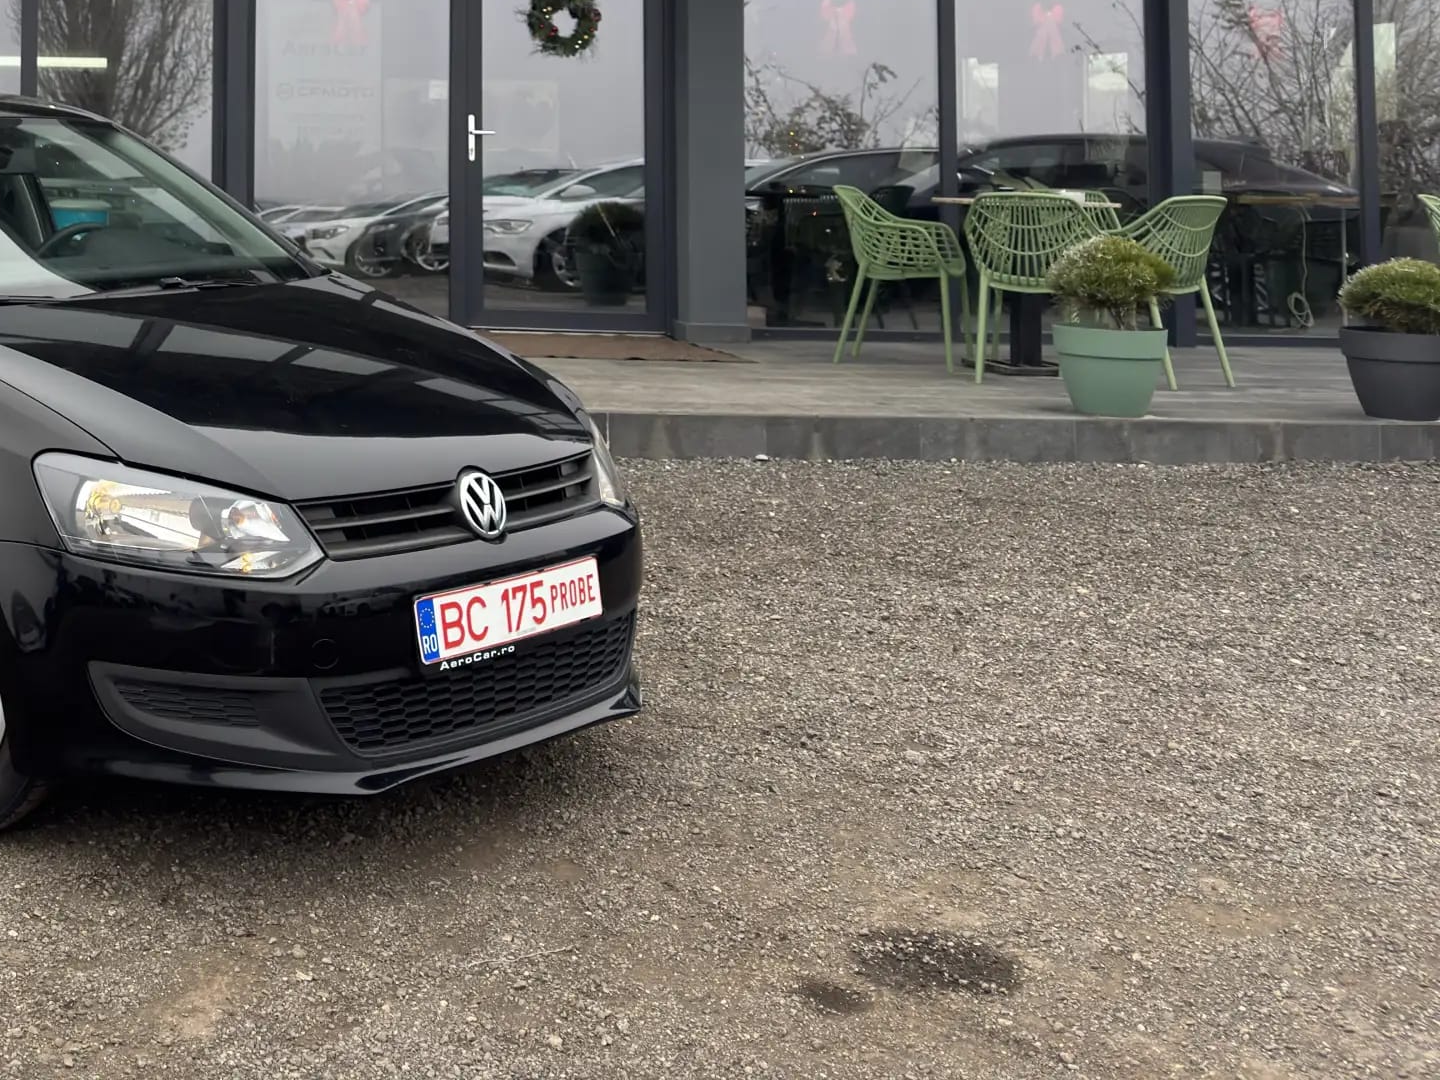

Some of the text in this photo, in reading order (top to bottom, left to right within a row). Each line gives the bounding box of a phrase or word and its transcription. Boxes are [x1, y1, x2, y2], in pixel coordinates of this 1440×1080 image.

[439, 573, 596, 650] BC 175 PROBE
[422, 635, 439, 655] RO
[439, 645, 516, 671] AeroCar.ro
